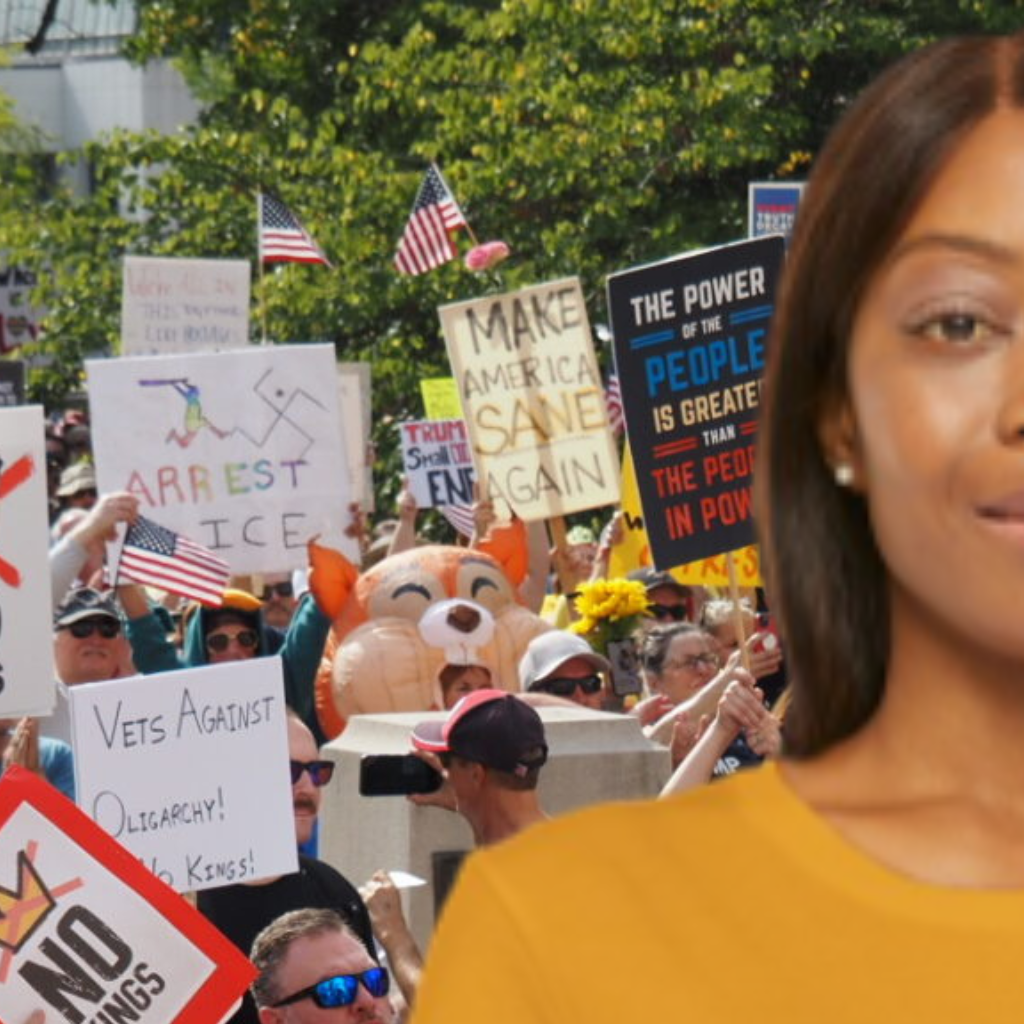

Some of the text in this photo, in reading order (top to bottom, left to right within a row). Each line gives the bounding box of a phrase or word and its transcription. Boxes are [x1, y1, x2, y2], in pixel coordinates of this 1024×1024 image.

[465, 287, 583, 354] MAKE
[630, 266, 765, 326] THE POWER
[682, 315, 722, 339] OF THE
[463, 353, 601, 398] AMERICA
[645, 328, 766, 397] PEOPLE
[474, 386, 607, 456] SANE
[653, 380, 763, 433] IS GREATE
[702, 425, 736, 446] THAN
[126, 458, 309, 507] ARREST
[488, 454, 607, 504] AGAIN
[652, 460, 699, 498] THE
[200, 513, 310, 550] ICE
[666, 503, 695, 540] IN
[93, 688, 275, 749] VETS AGAINST
